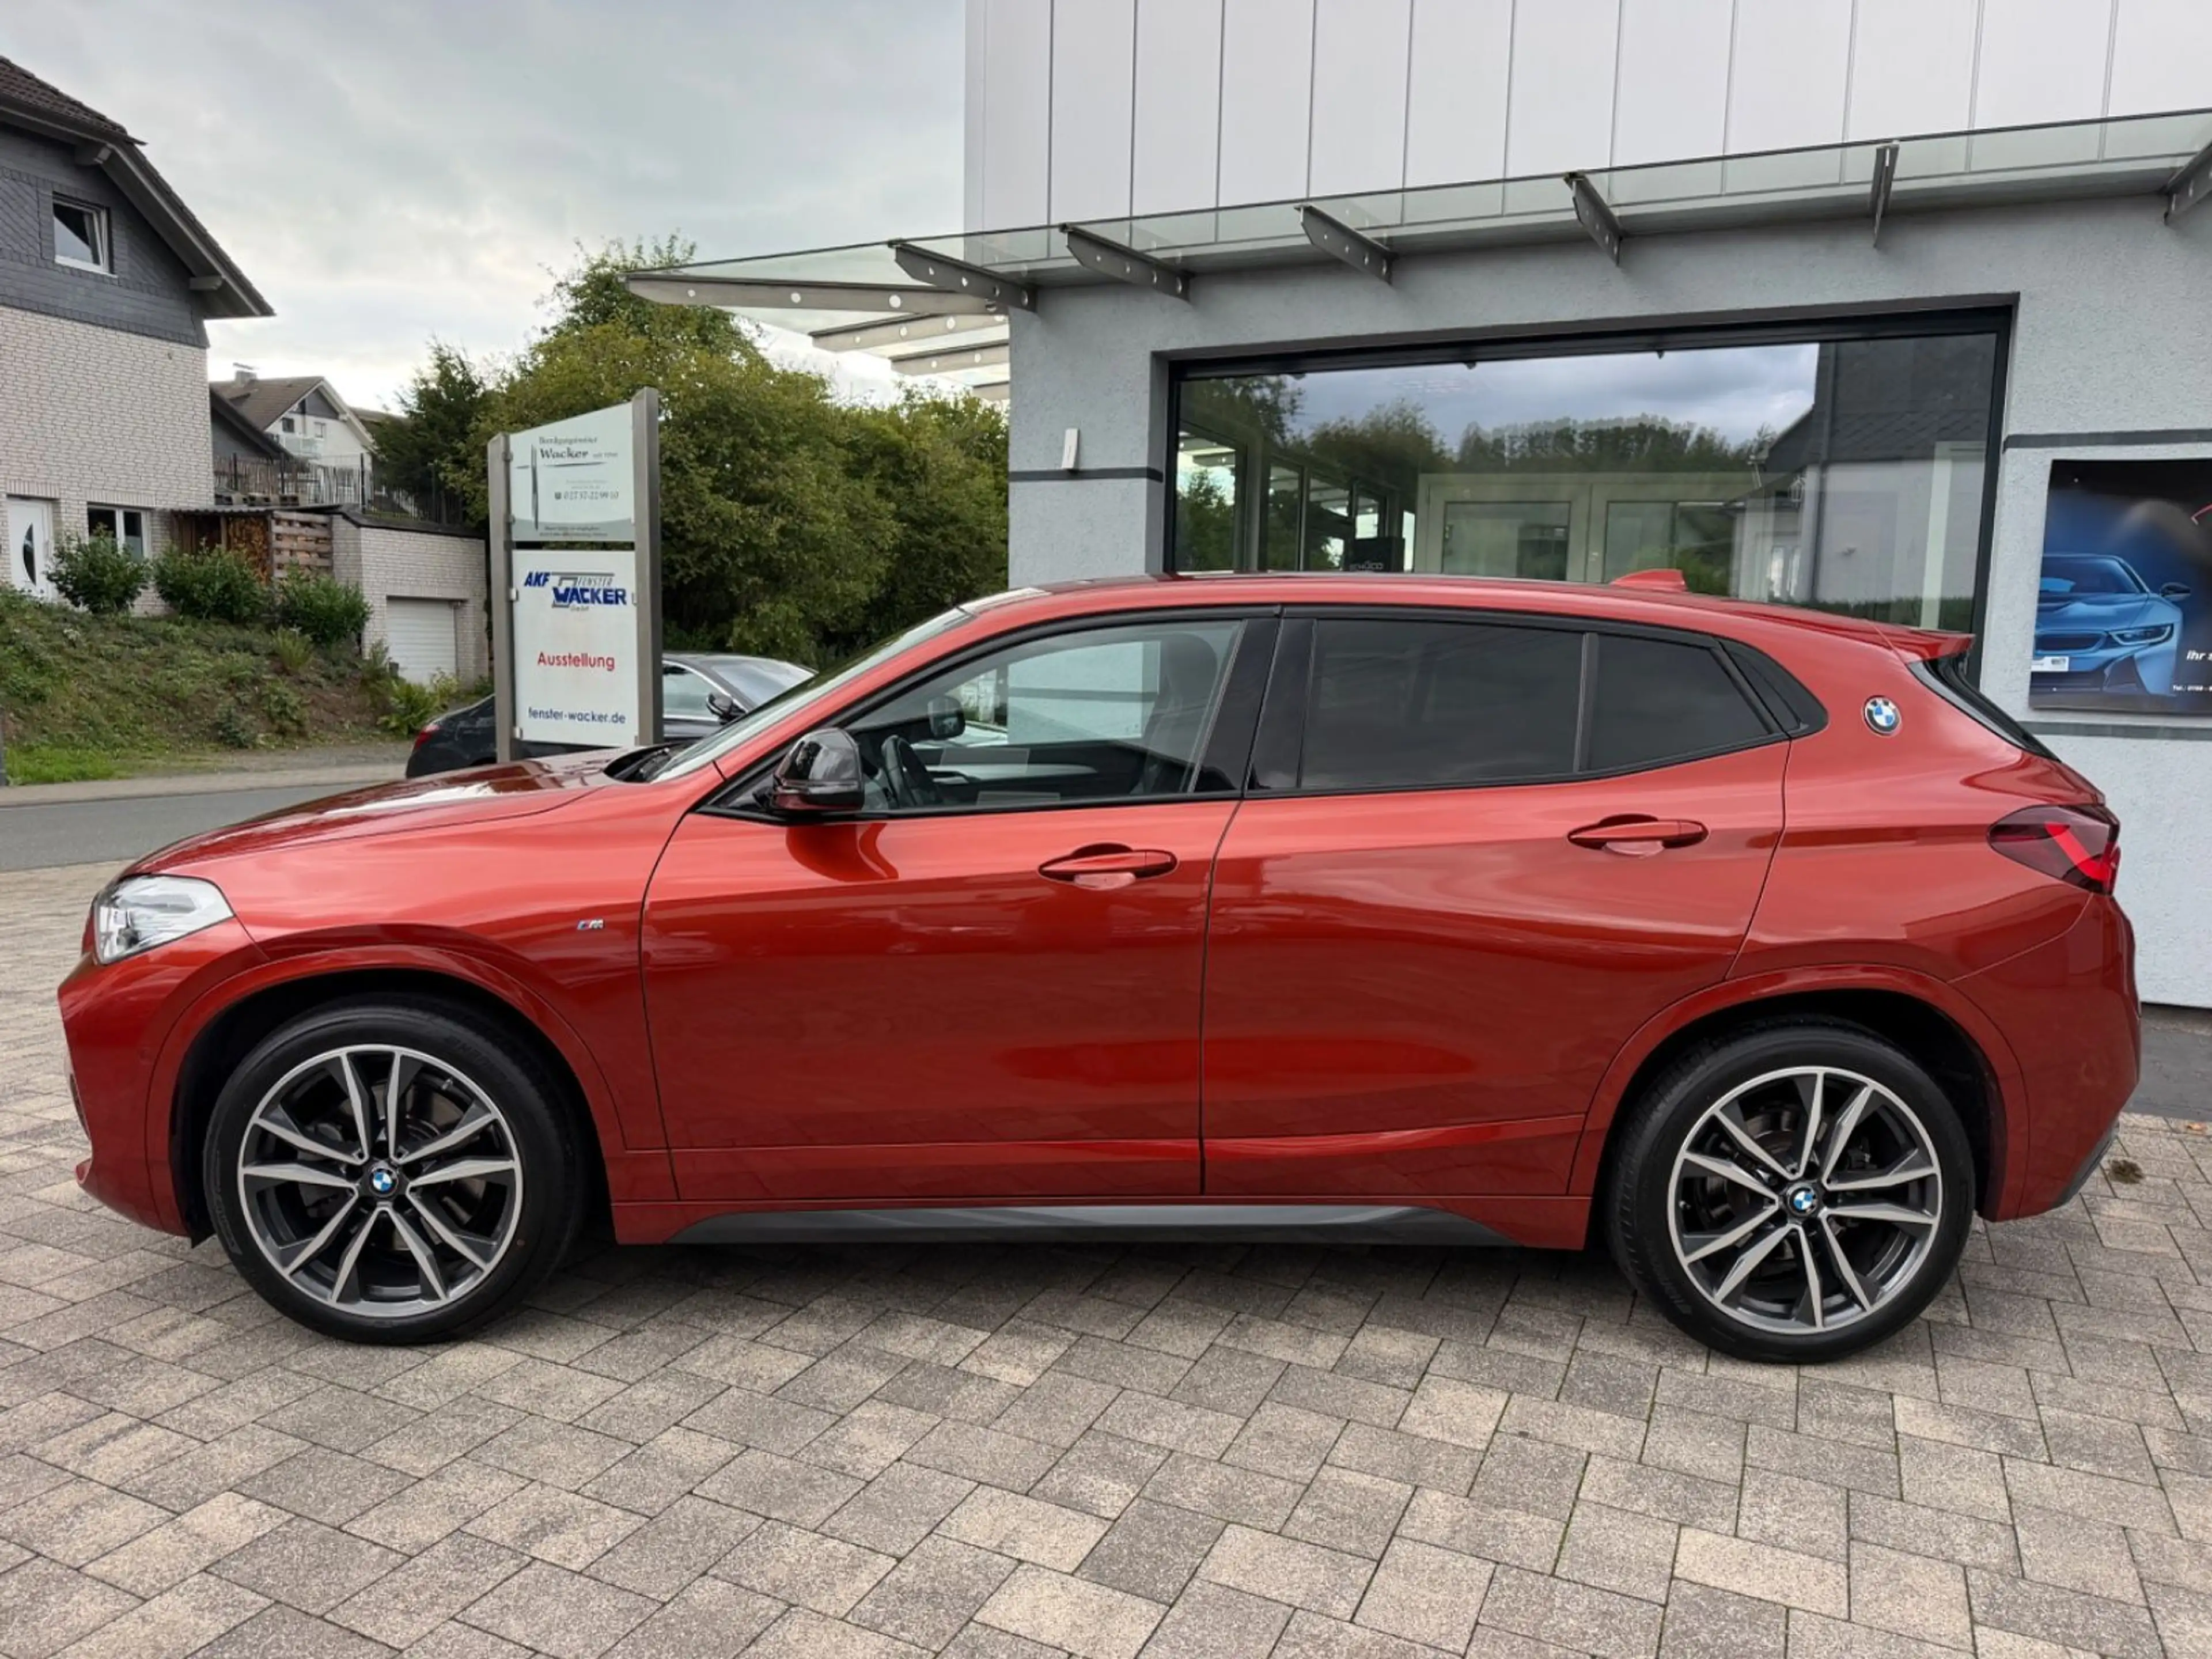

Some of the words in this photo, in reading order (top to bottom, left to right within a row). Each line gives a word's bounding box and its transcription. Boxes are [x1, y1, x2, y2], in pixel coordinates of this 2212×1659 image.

[540, 447, 588, 459] Wacker
[524, 572, 550, 586] AKF
[552, 587, 627, 604] WACKER
[537, 652, 615, 671] Ausstellung
[528, 706, 626, 724] fenster-wacker.de
